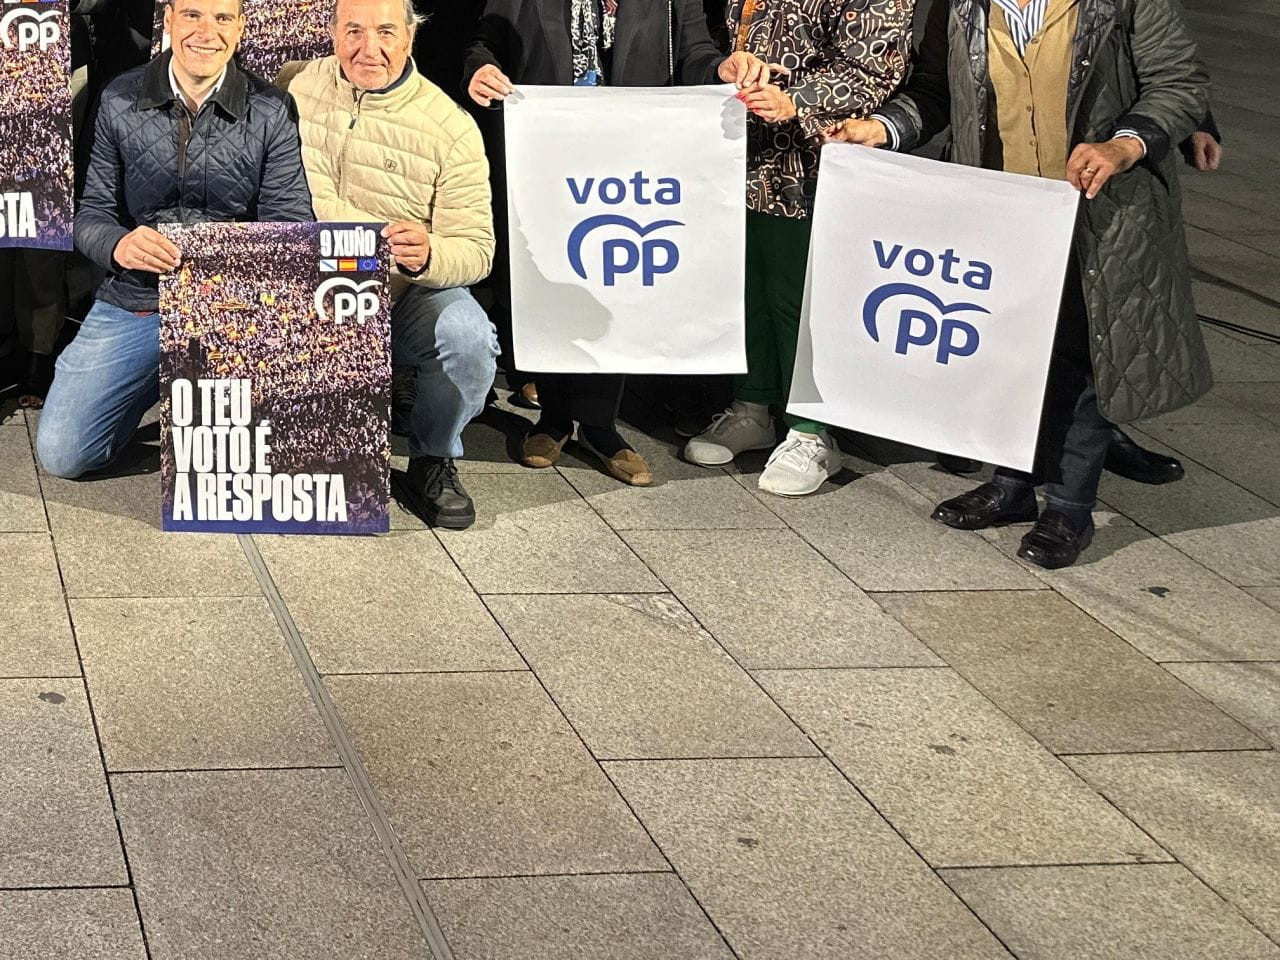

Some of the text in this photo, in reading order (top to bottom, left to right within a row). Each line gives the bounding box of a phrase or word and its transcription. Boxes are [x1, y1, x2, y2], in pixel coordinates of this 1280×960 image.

[566, 171, 681, 205] vota
[320, 226, 376, 257] 9 XUÑO
[872, 240, 994, 291] vota
[172, 378, 252, 426] O TEU
[172, 419, 272, 473] VOTO É
[172, 473, 348, 522] A RESPOSTA
